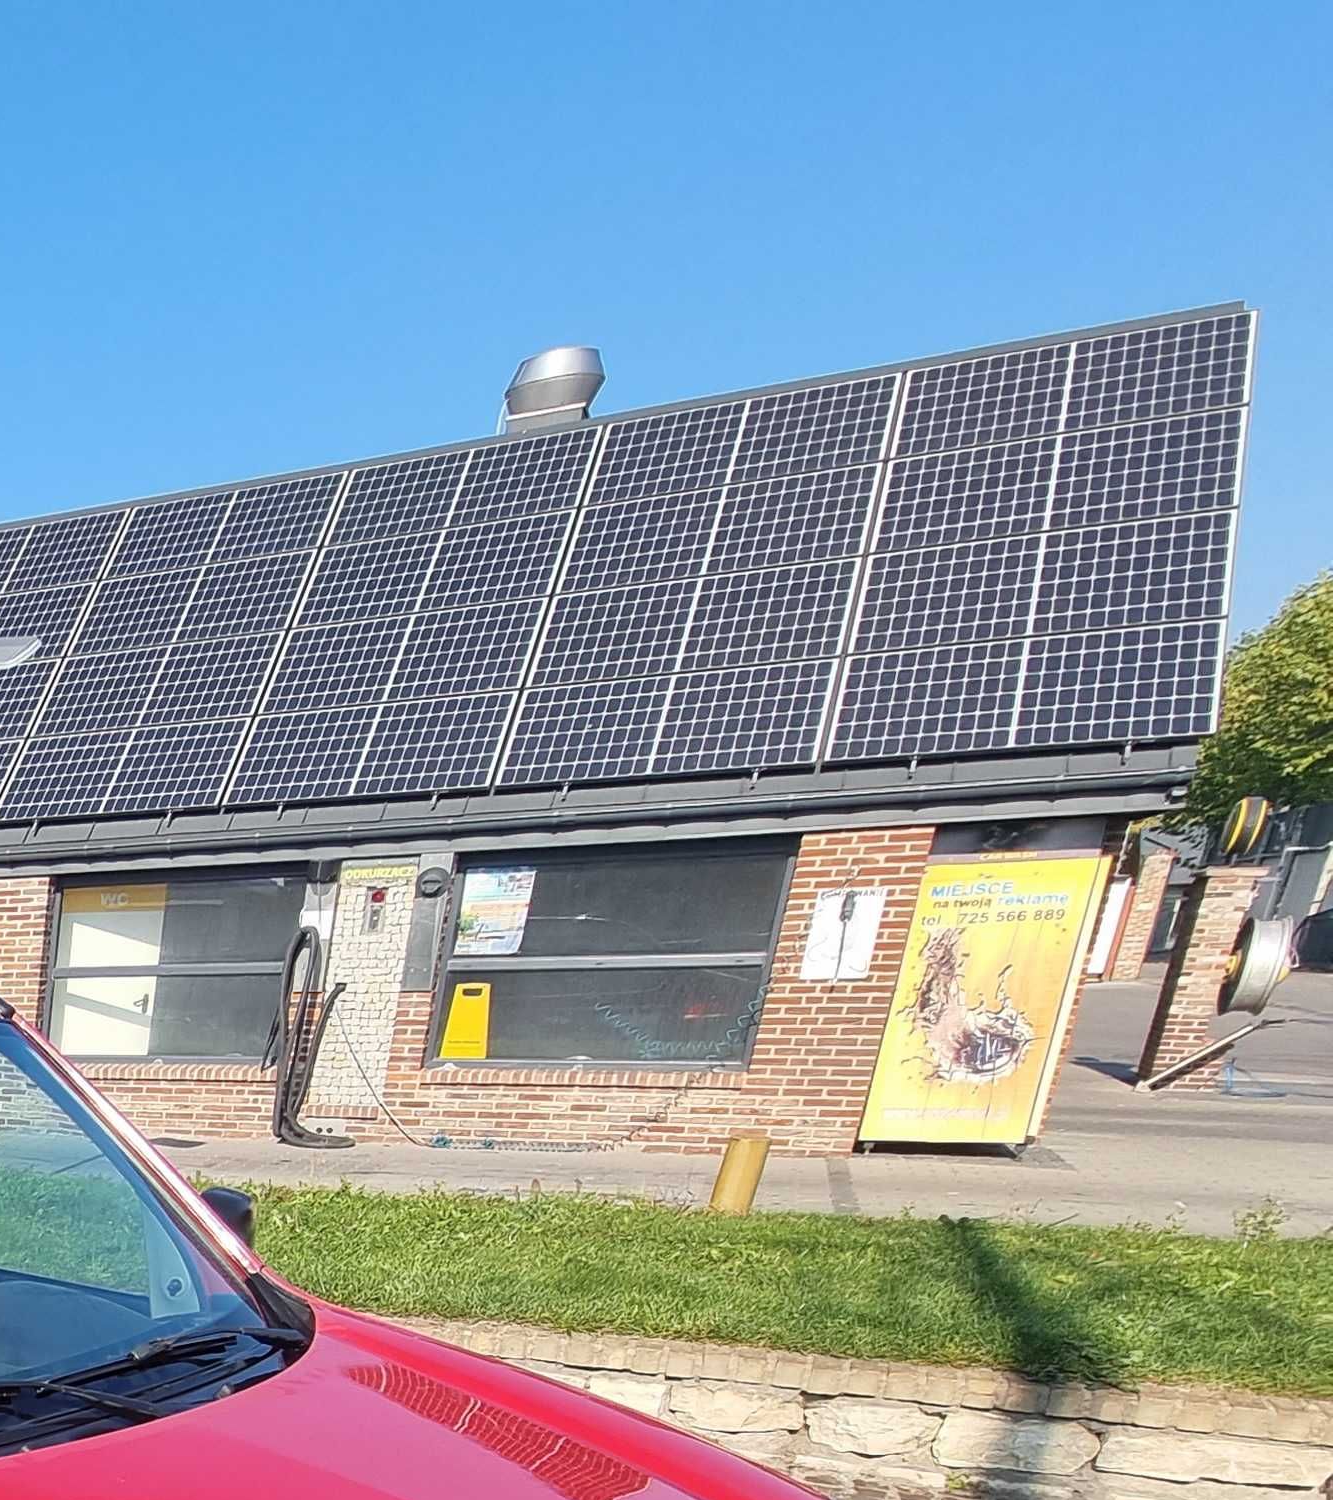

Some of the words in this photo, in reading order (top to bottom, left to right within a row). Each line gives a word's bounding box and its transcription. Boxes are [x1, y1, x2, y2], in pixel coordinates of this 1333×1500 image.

[345, 866, 414, 880] ODKURZACZ
[931, 881, 1014, 898] MIEJSCE
[100, 892, 129, 905] WC
[933, 899, 950, 909] na
[953, 897, 993, 910] twoją
[997, 893, 1070, 906] reklamę
[959, 912, 990, 926] 725
[996, 910, 1028, 923] 566
[1034, 908, 1067, 921] 889
